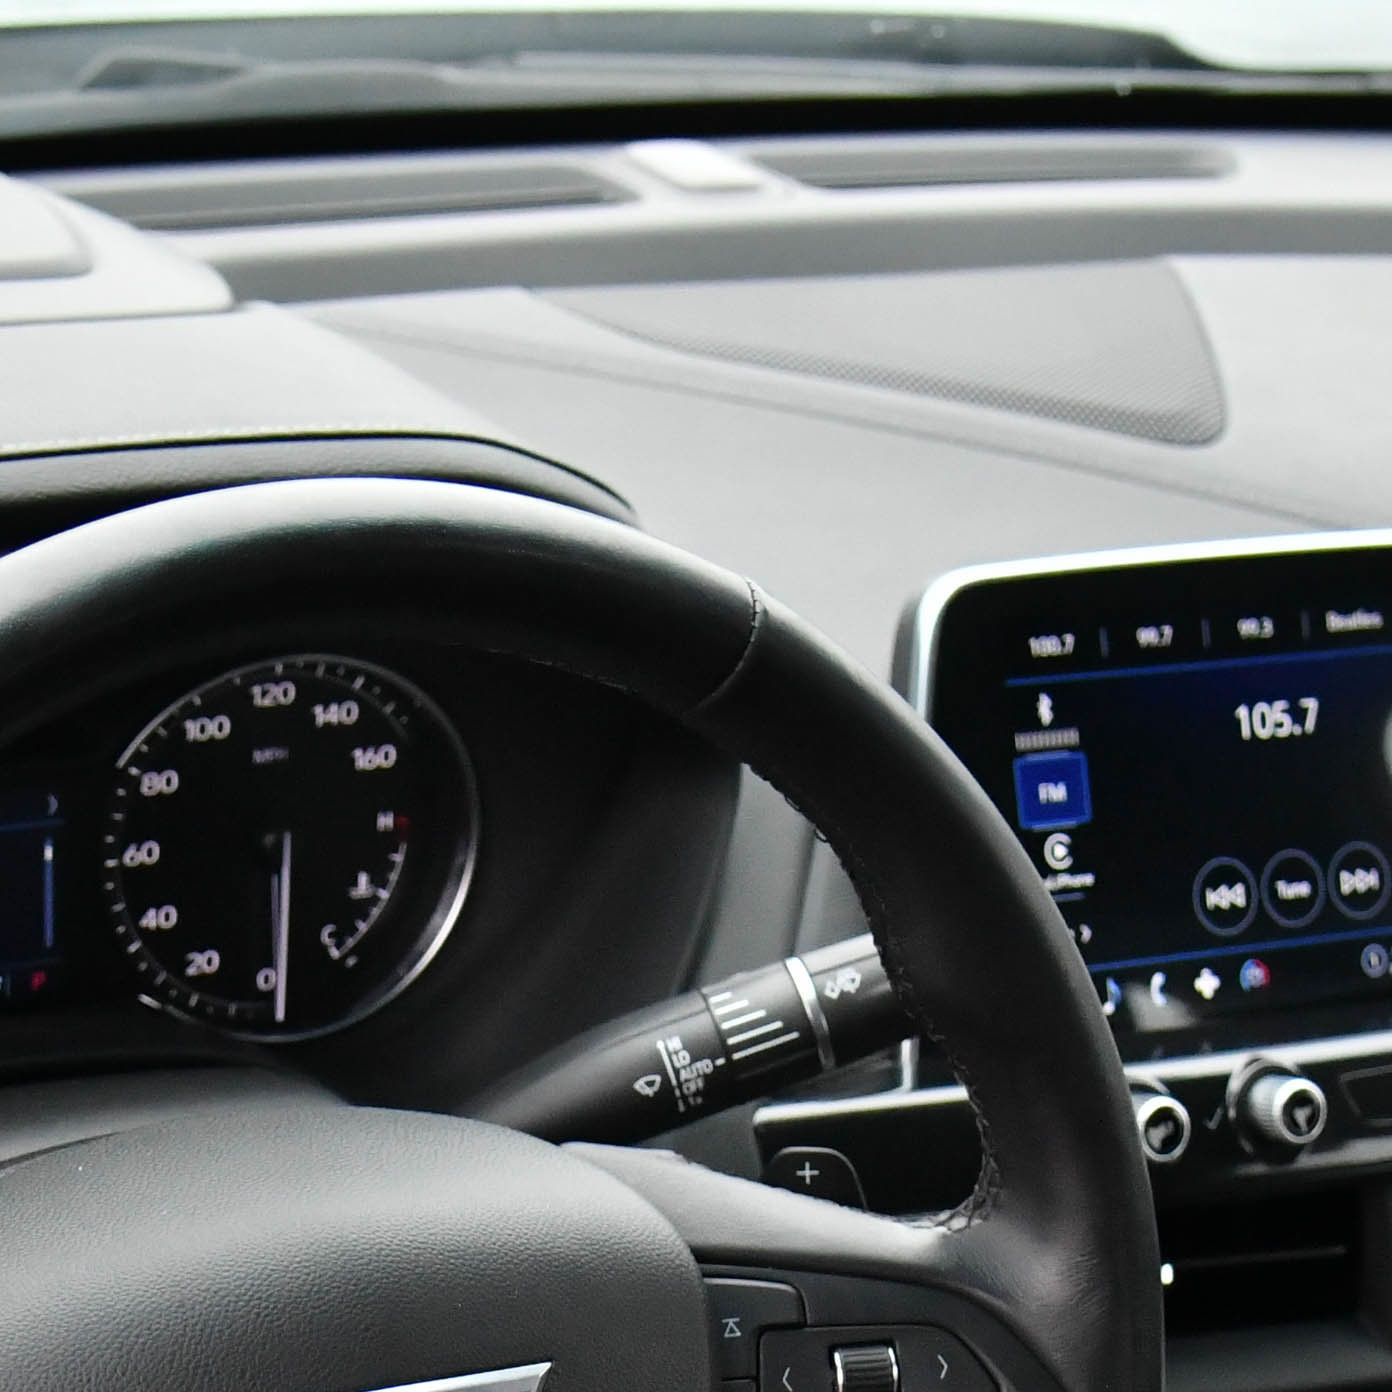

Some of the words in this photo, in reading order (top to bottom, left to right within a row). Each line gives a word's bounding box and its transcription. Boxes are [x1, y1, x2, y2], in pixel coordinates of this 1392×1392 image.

[250, 681, 296, 708] 120
[313, 700, 360, 728] 140
[1235, 697, 1319, 740] 105.7
[184, 714, 231, 743] 100
[351, 744, 397, 771] 160
[139, 769, 179, 797] 80
[1038, 782, 1068, 804] FM
[122, 840, 160, 868] 60
[139, 904, 178, 931] 40
[185, 949, 220, 977] 20
[256, 967, 277, 992] 0
[680, 1059, 714, 1083] AUTO
